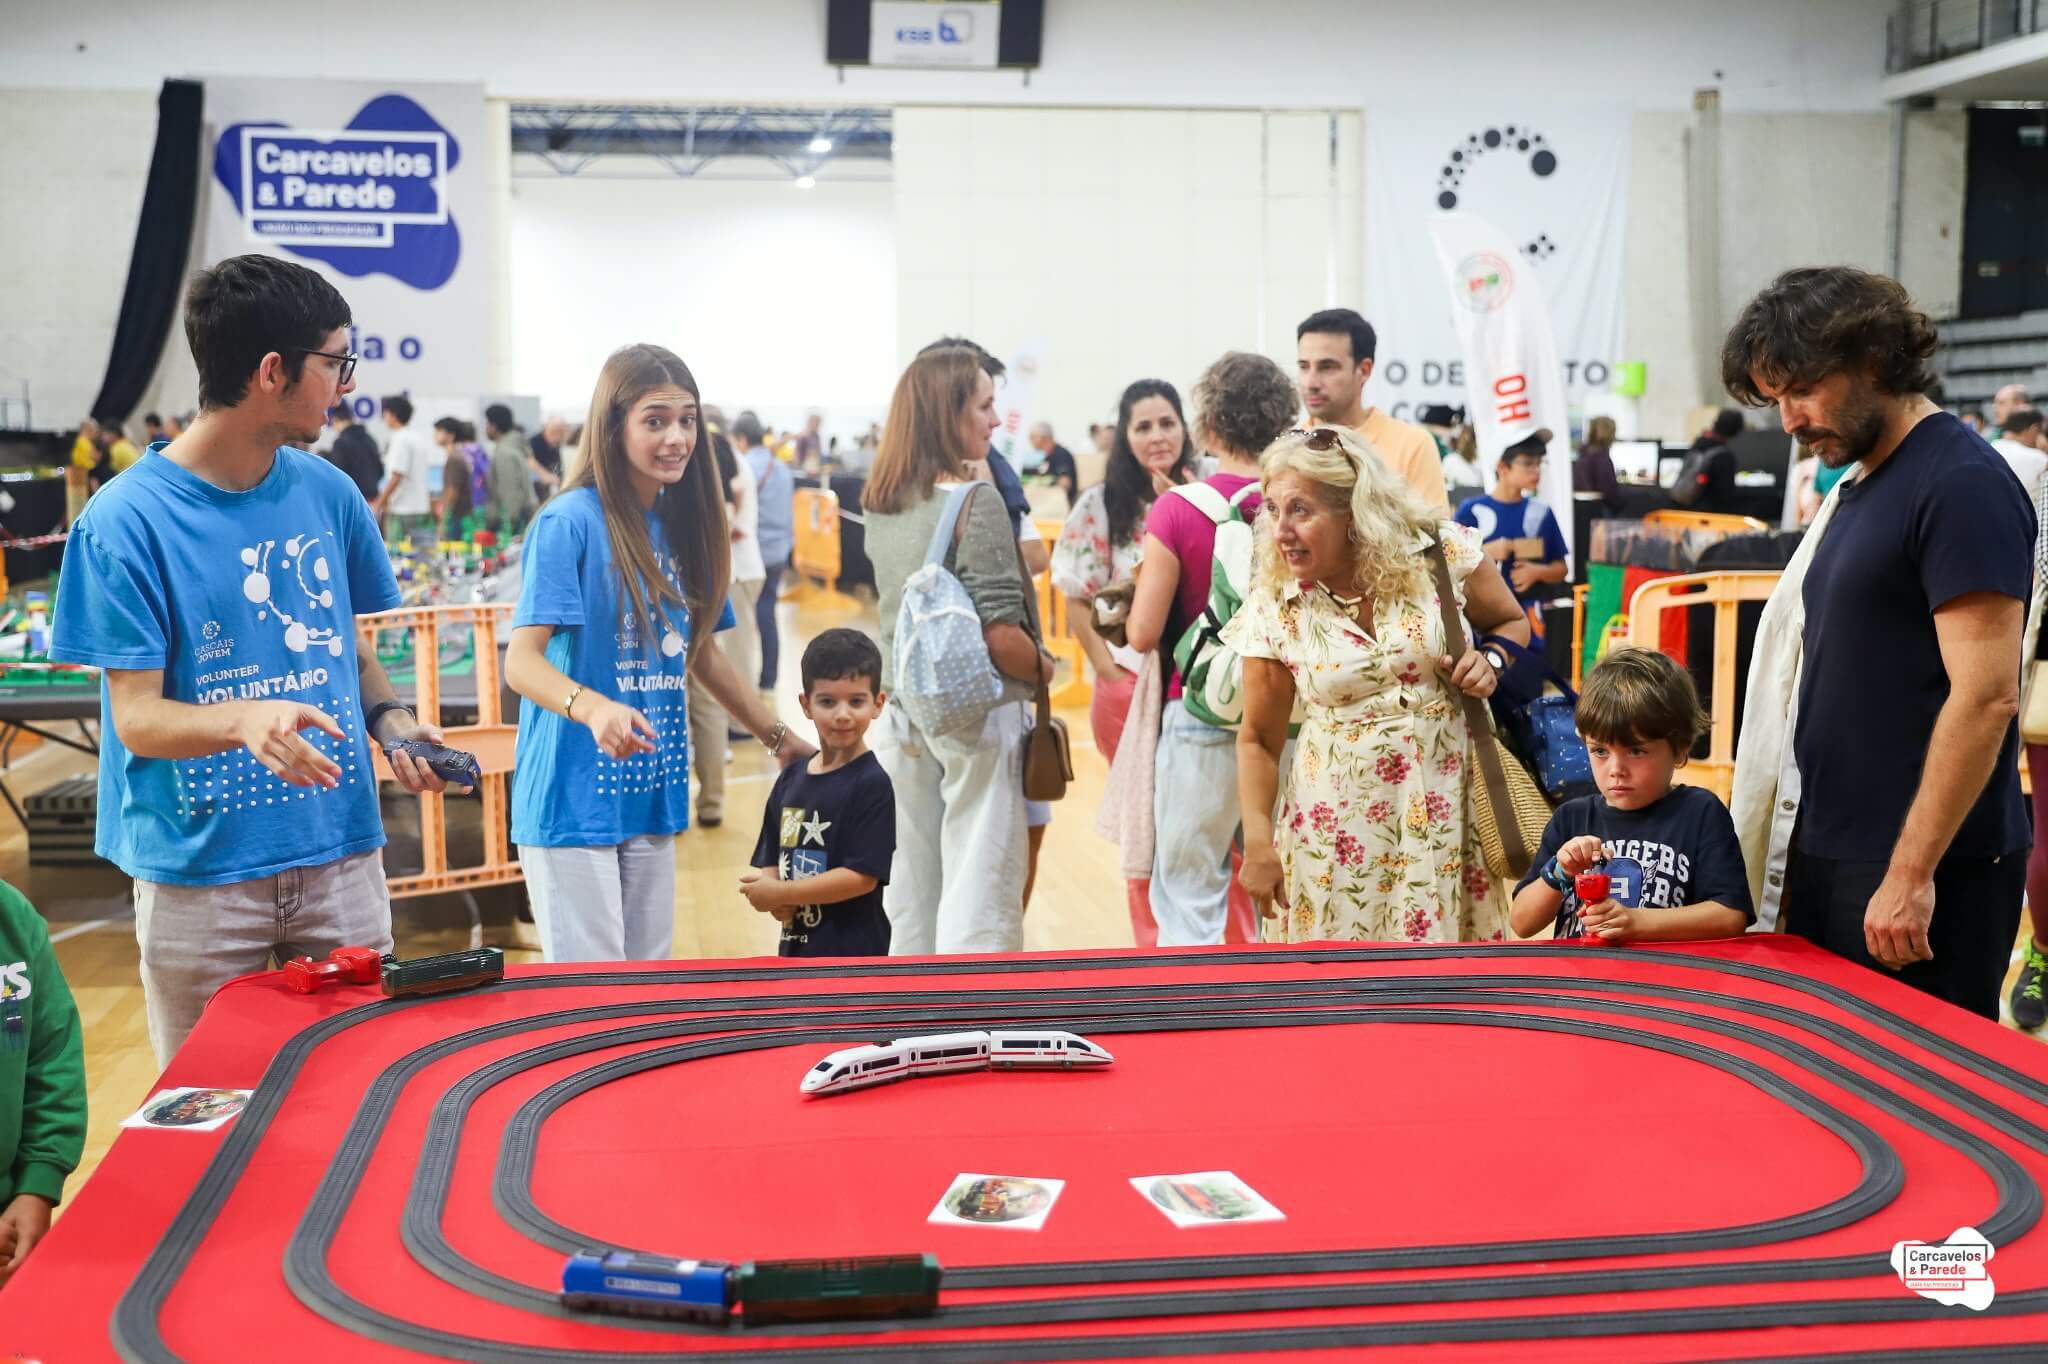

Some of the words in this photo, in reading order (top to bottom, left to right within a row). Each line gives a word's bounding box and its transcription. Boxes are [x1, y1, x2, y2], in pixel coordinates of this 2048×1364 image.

[256, 142, 433, 178] Carcavelos
[257, 182, 278, 206] &
[282, 176, 397, 209] Parede
[1385, 361, 1408, 386] O
[194, 638, 235, 657] CASCAIS
[198, 647, 232, 664] JOVEM
[195, 664, 260, 686] VOLUNTEER
[197, 667, 328, 704] VOLUNTÁRIO
[1601, 839, 1691, 883] NGERS
